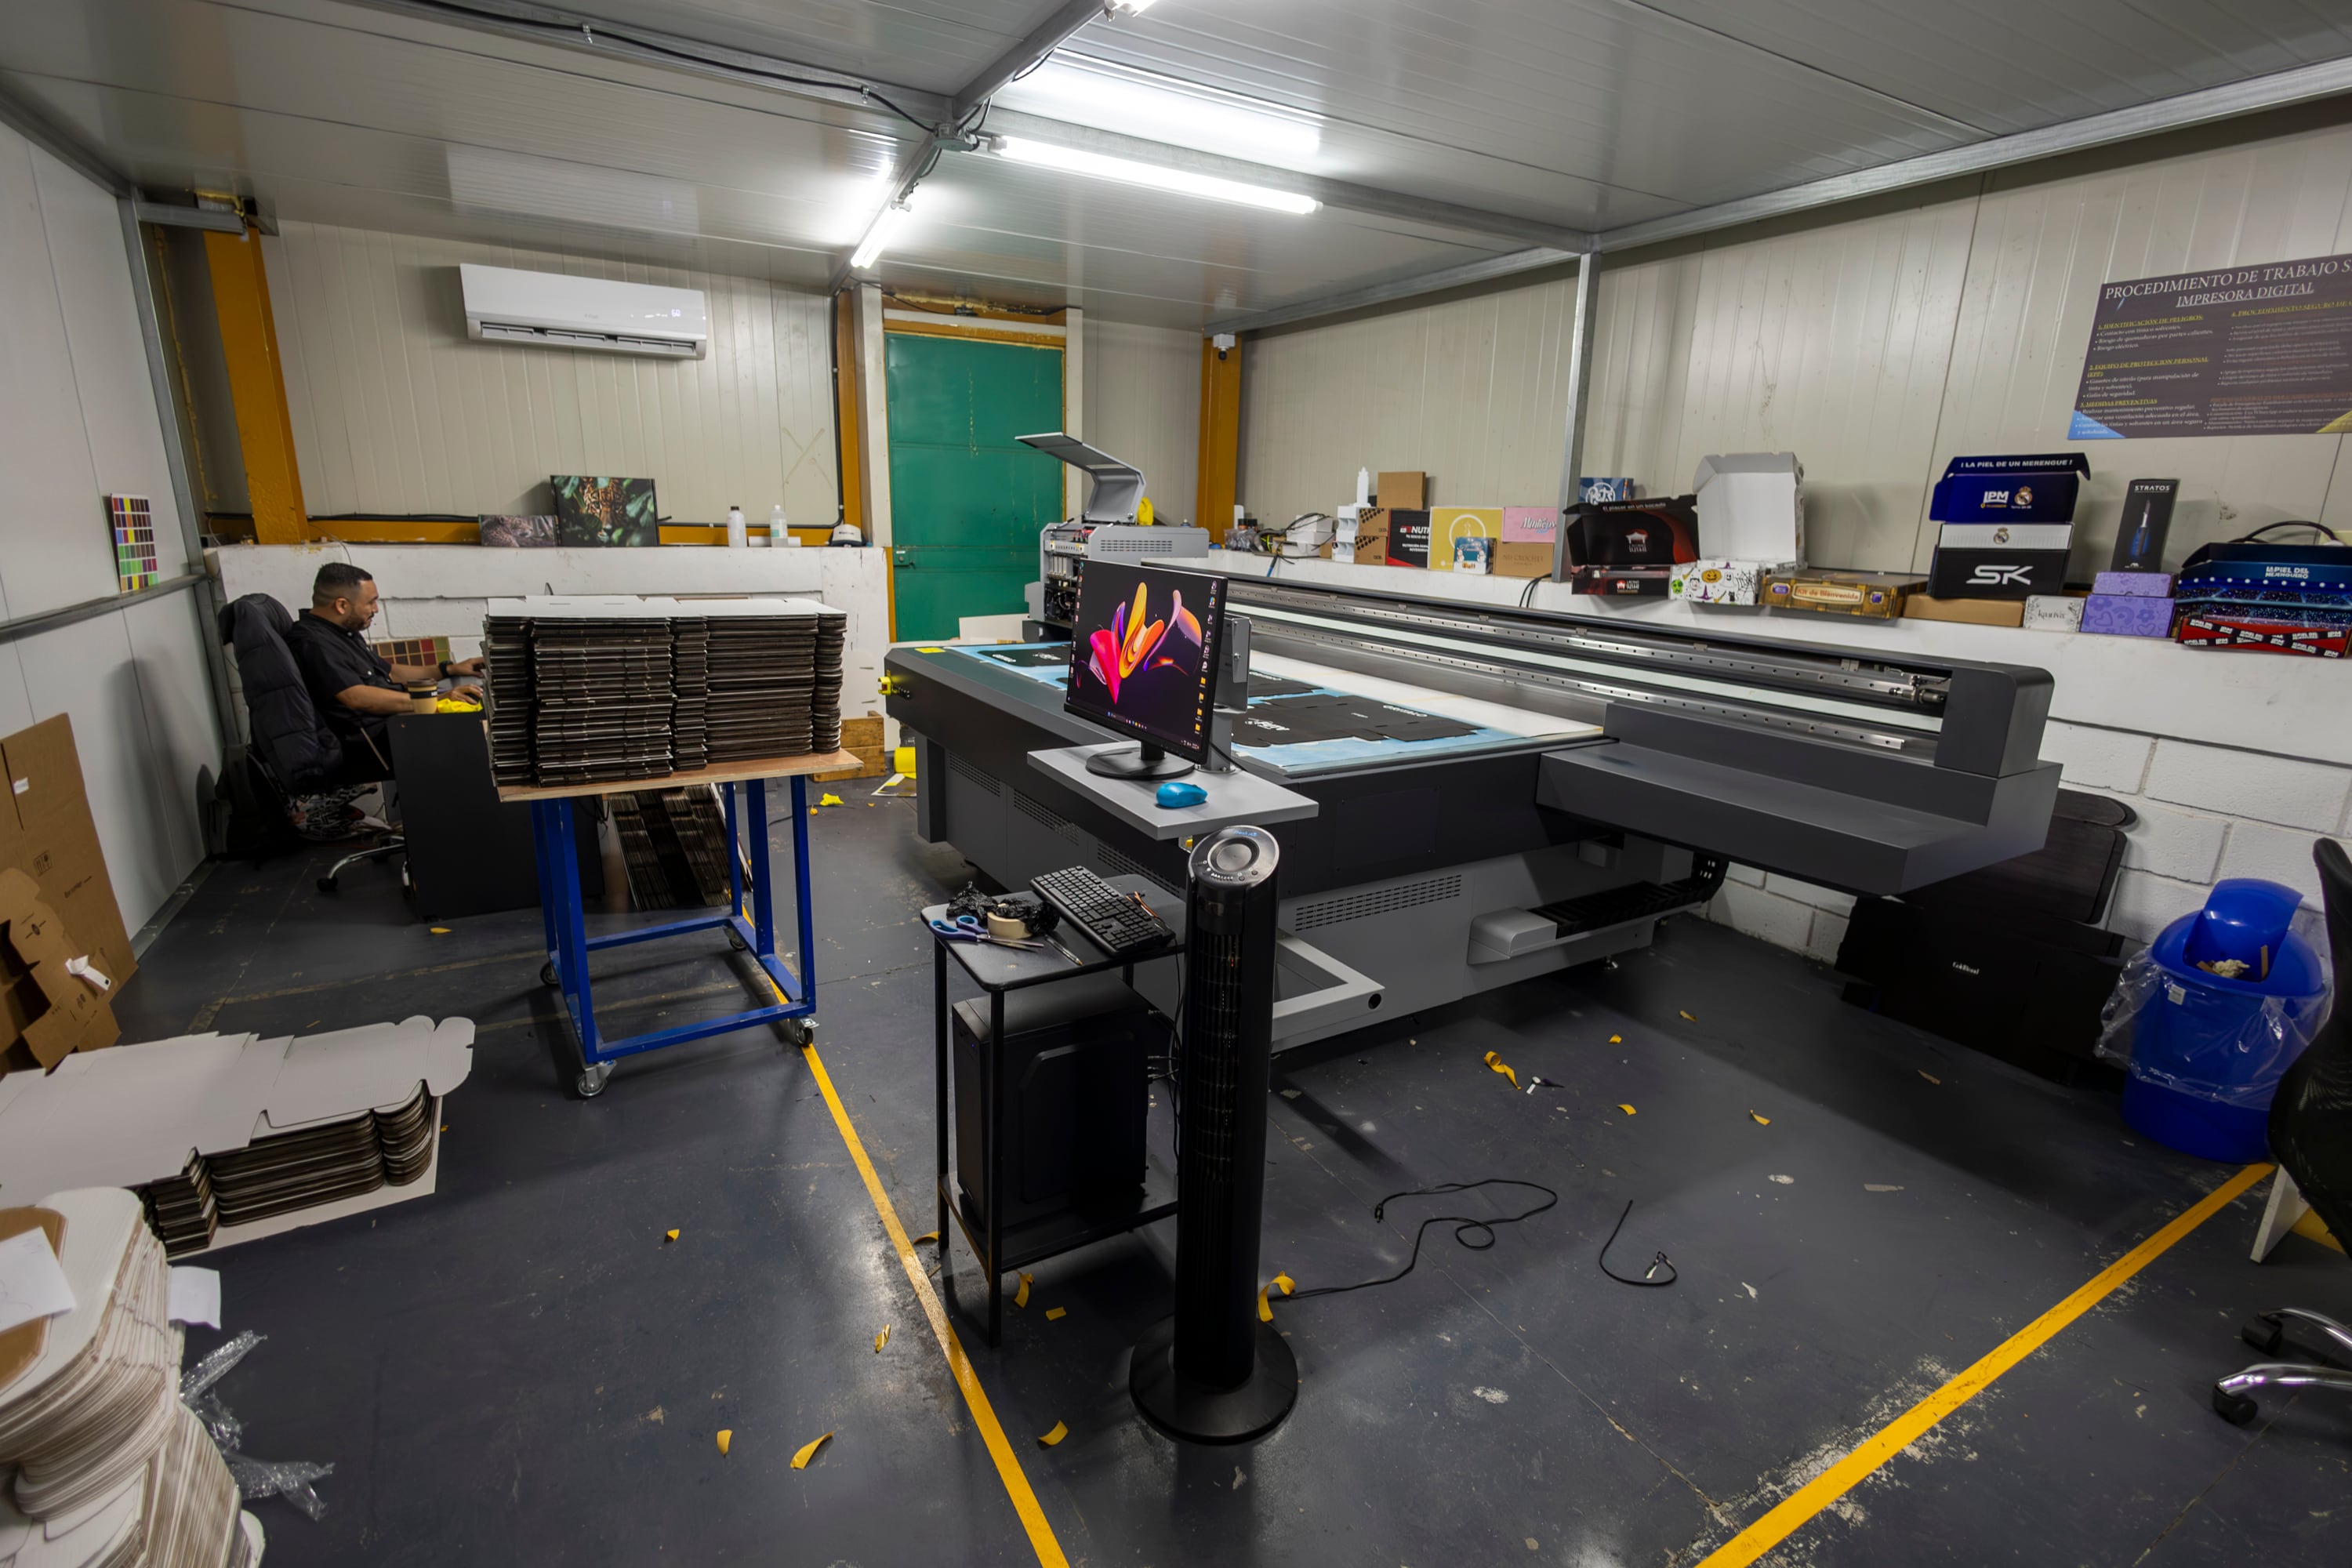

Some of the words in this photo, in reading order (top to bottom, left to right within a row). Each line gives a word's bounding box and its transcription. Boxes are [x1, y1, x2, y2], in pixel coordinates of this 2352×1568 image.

[2105, 273, 2233, 299] PROCEDIMIENTO
[2236, 270, 2259, 284] DE
[2263, 261, 2338, 281] TRABAJO
[2176, 289, 2252, 307] IMPRESORA
[2257, 282, 2314, 298] DIGITAL
[1965, 564, 2034, 586] SK
[1820, 590, 1858, 600] Bienvenida
